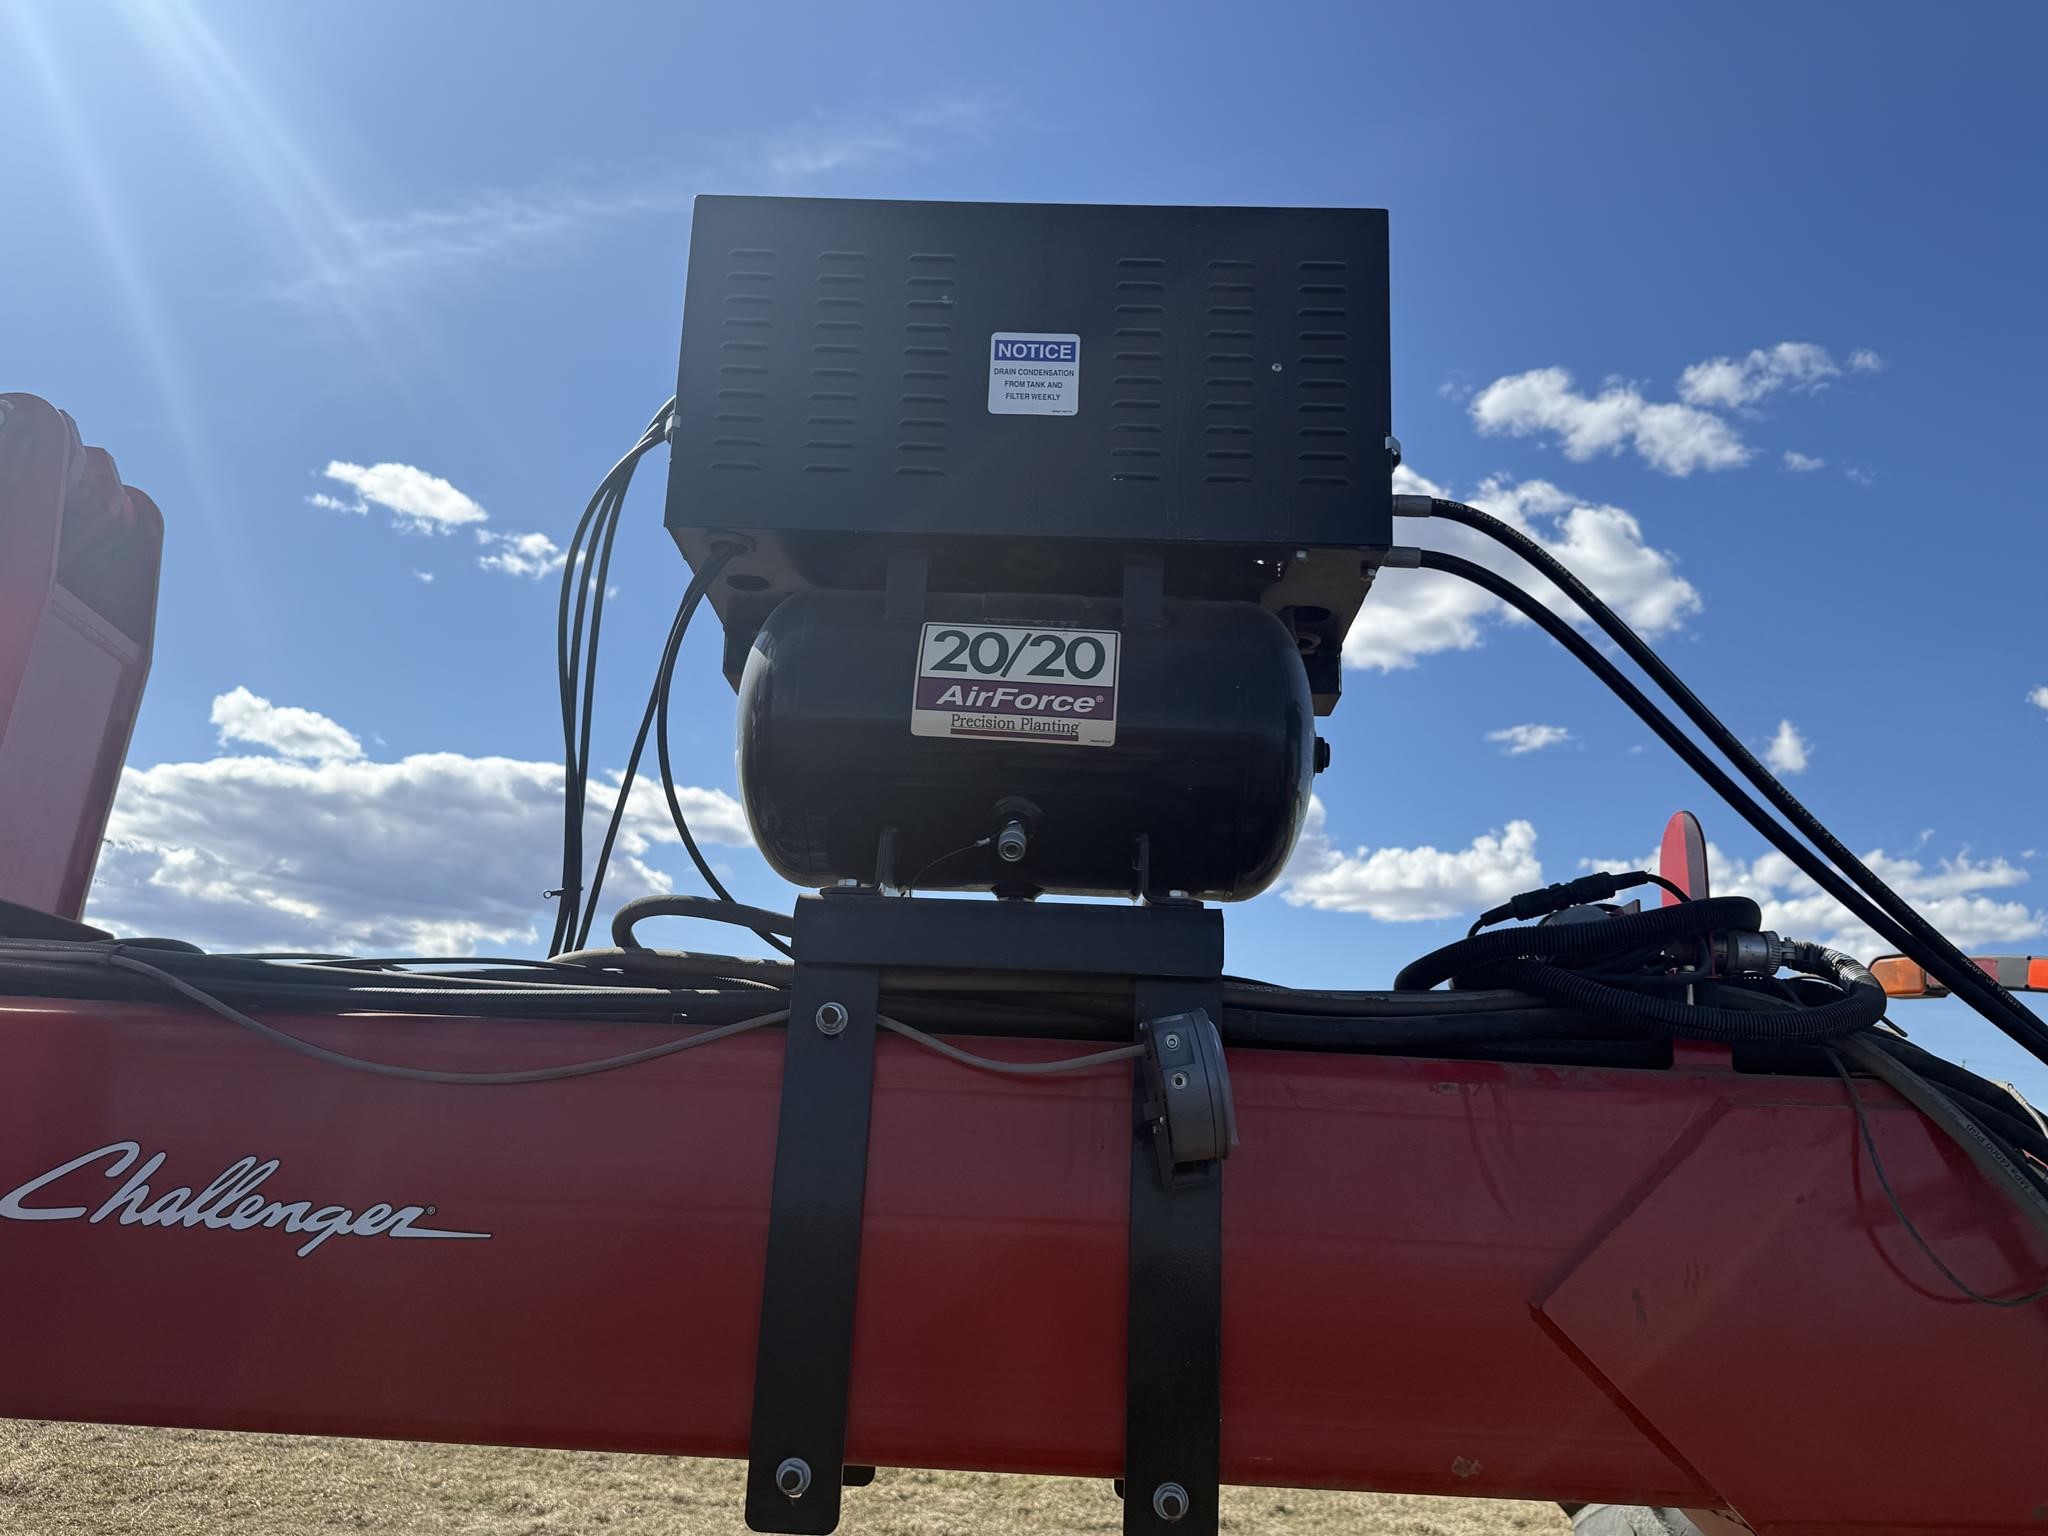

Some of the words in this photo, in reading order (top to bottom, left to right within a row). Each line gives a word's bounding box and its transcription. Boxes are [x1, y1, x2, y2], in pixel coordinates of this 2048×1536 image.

[998, 343, 1072, 359] NOTICE
[1018, 368, 1075, 377] CONDENSATION
[1004, 380, 1026, 388] FROM
[1027, 381, 1046, 389] TANK
[1047, 381, 1063, 389] AND
[1005, 392, 1030, 400] FILTER
[1031, 393, 1061, 401] WEEKLY
[929, 629, 1106, 680] 20/20
[951, 713, 1015, 730] Precision
[1020, 717, 1080, 735] Planting
